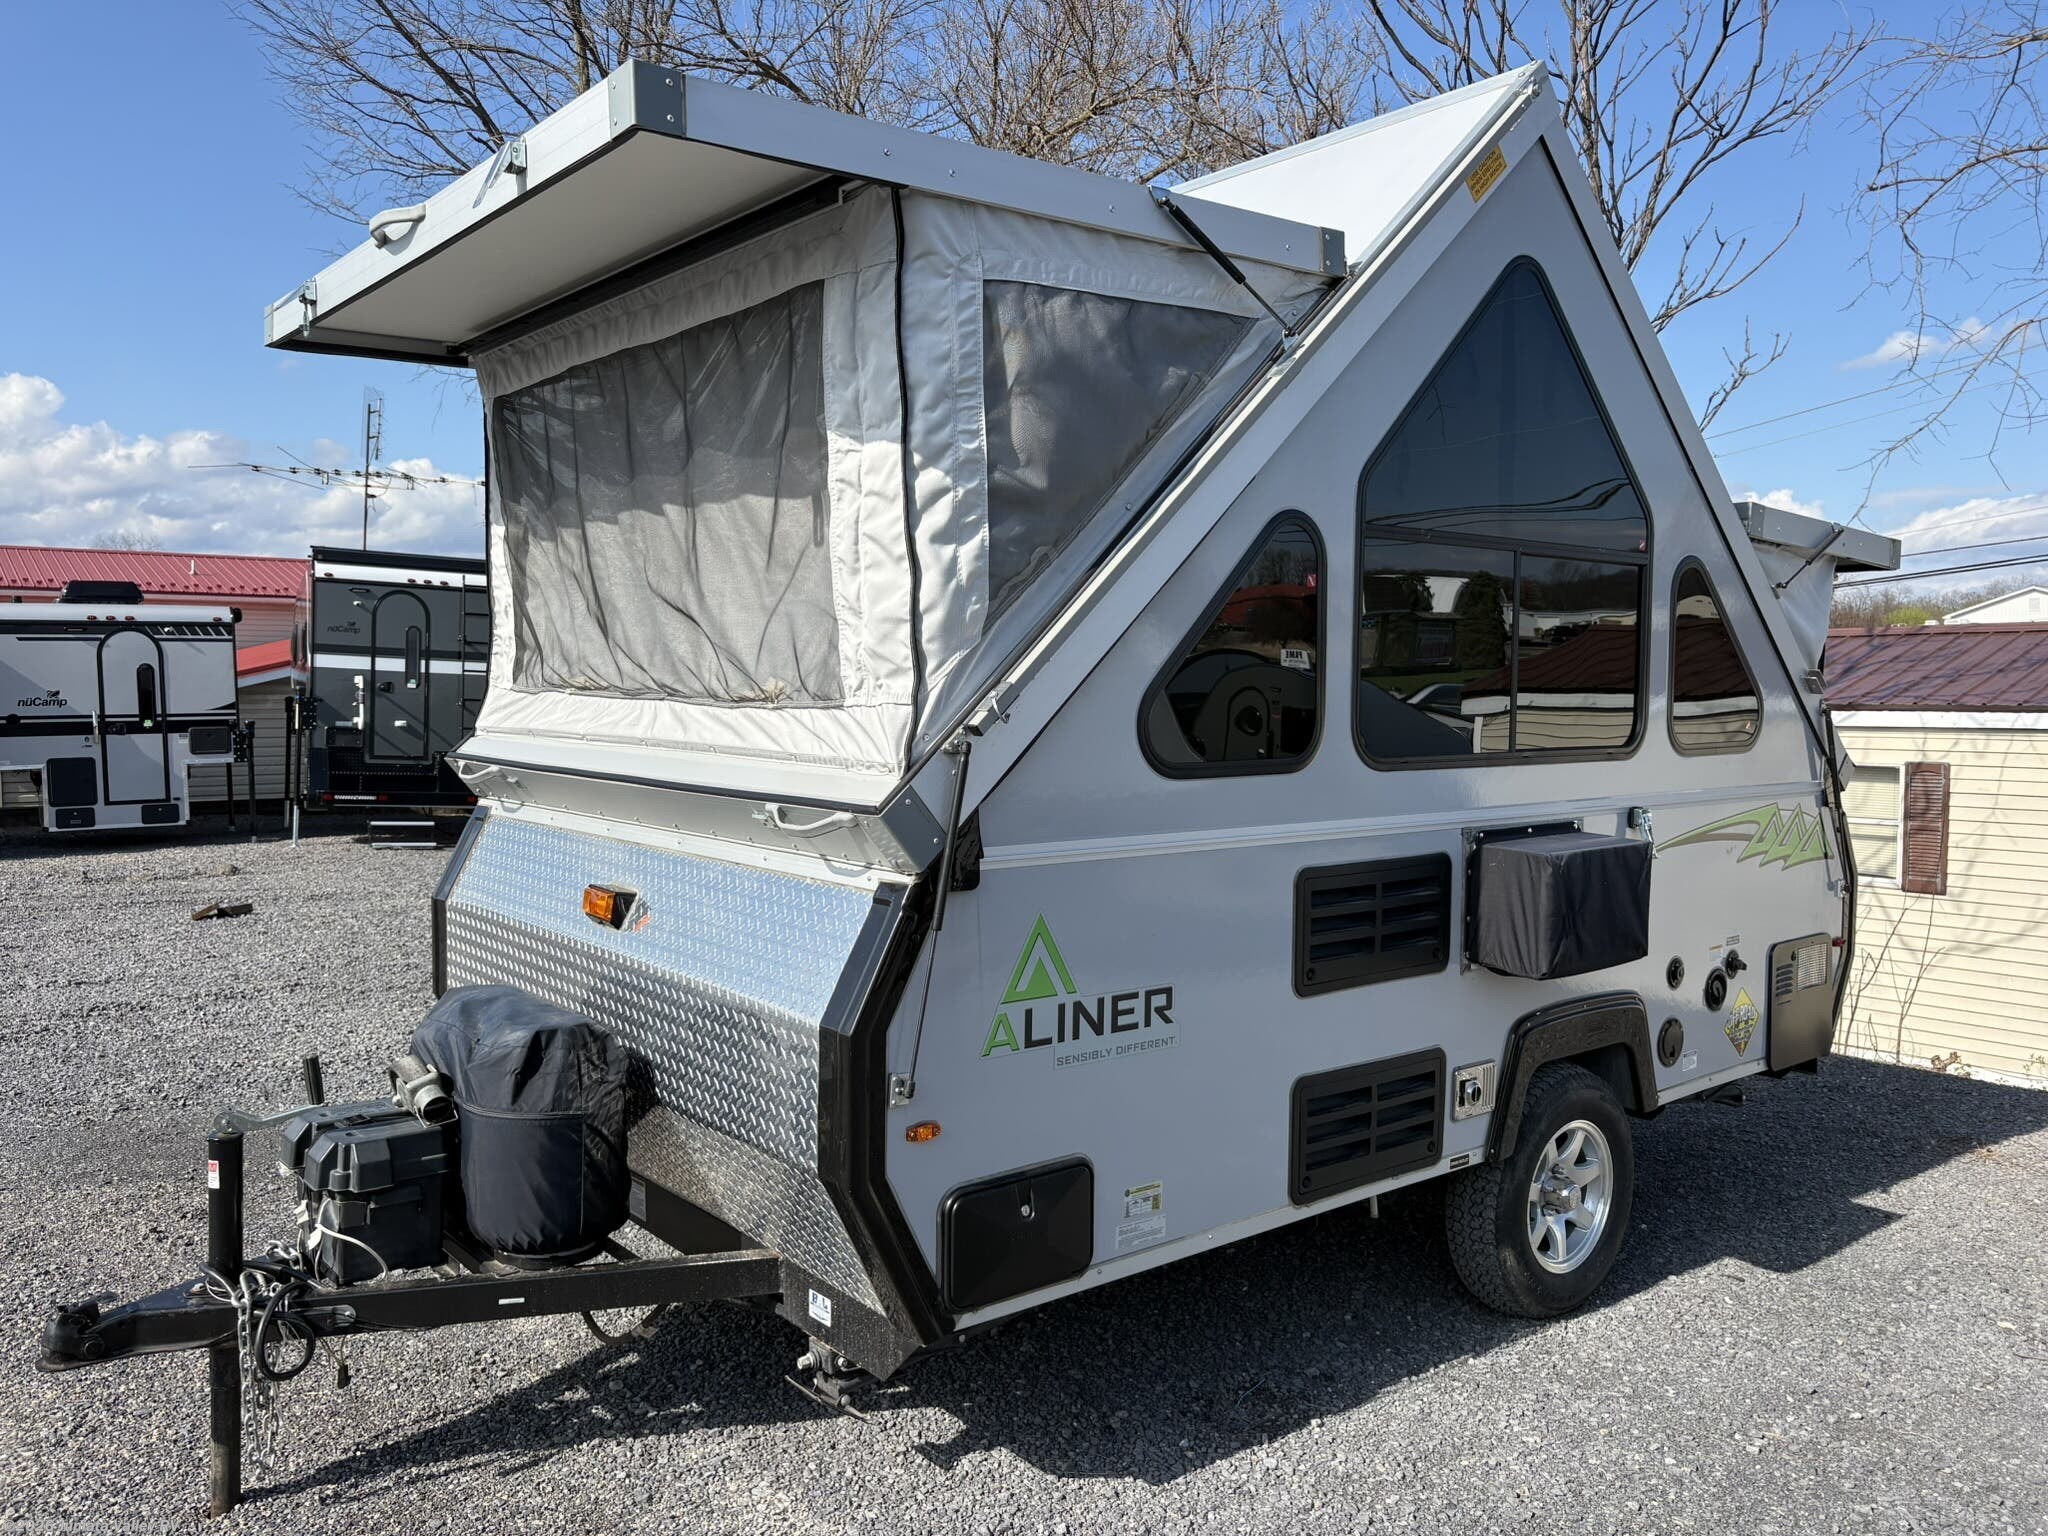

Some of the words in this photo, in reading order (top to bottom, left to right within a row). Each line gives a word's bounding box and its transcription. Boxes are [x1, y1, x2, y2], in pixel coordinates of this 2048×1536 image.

[17, 697, 68, 708] nüCamp
[980, 985, 1174, 1057] ALINER
[1056, 1047, 1113, 1067] SENSIBLY
